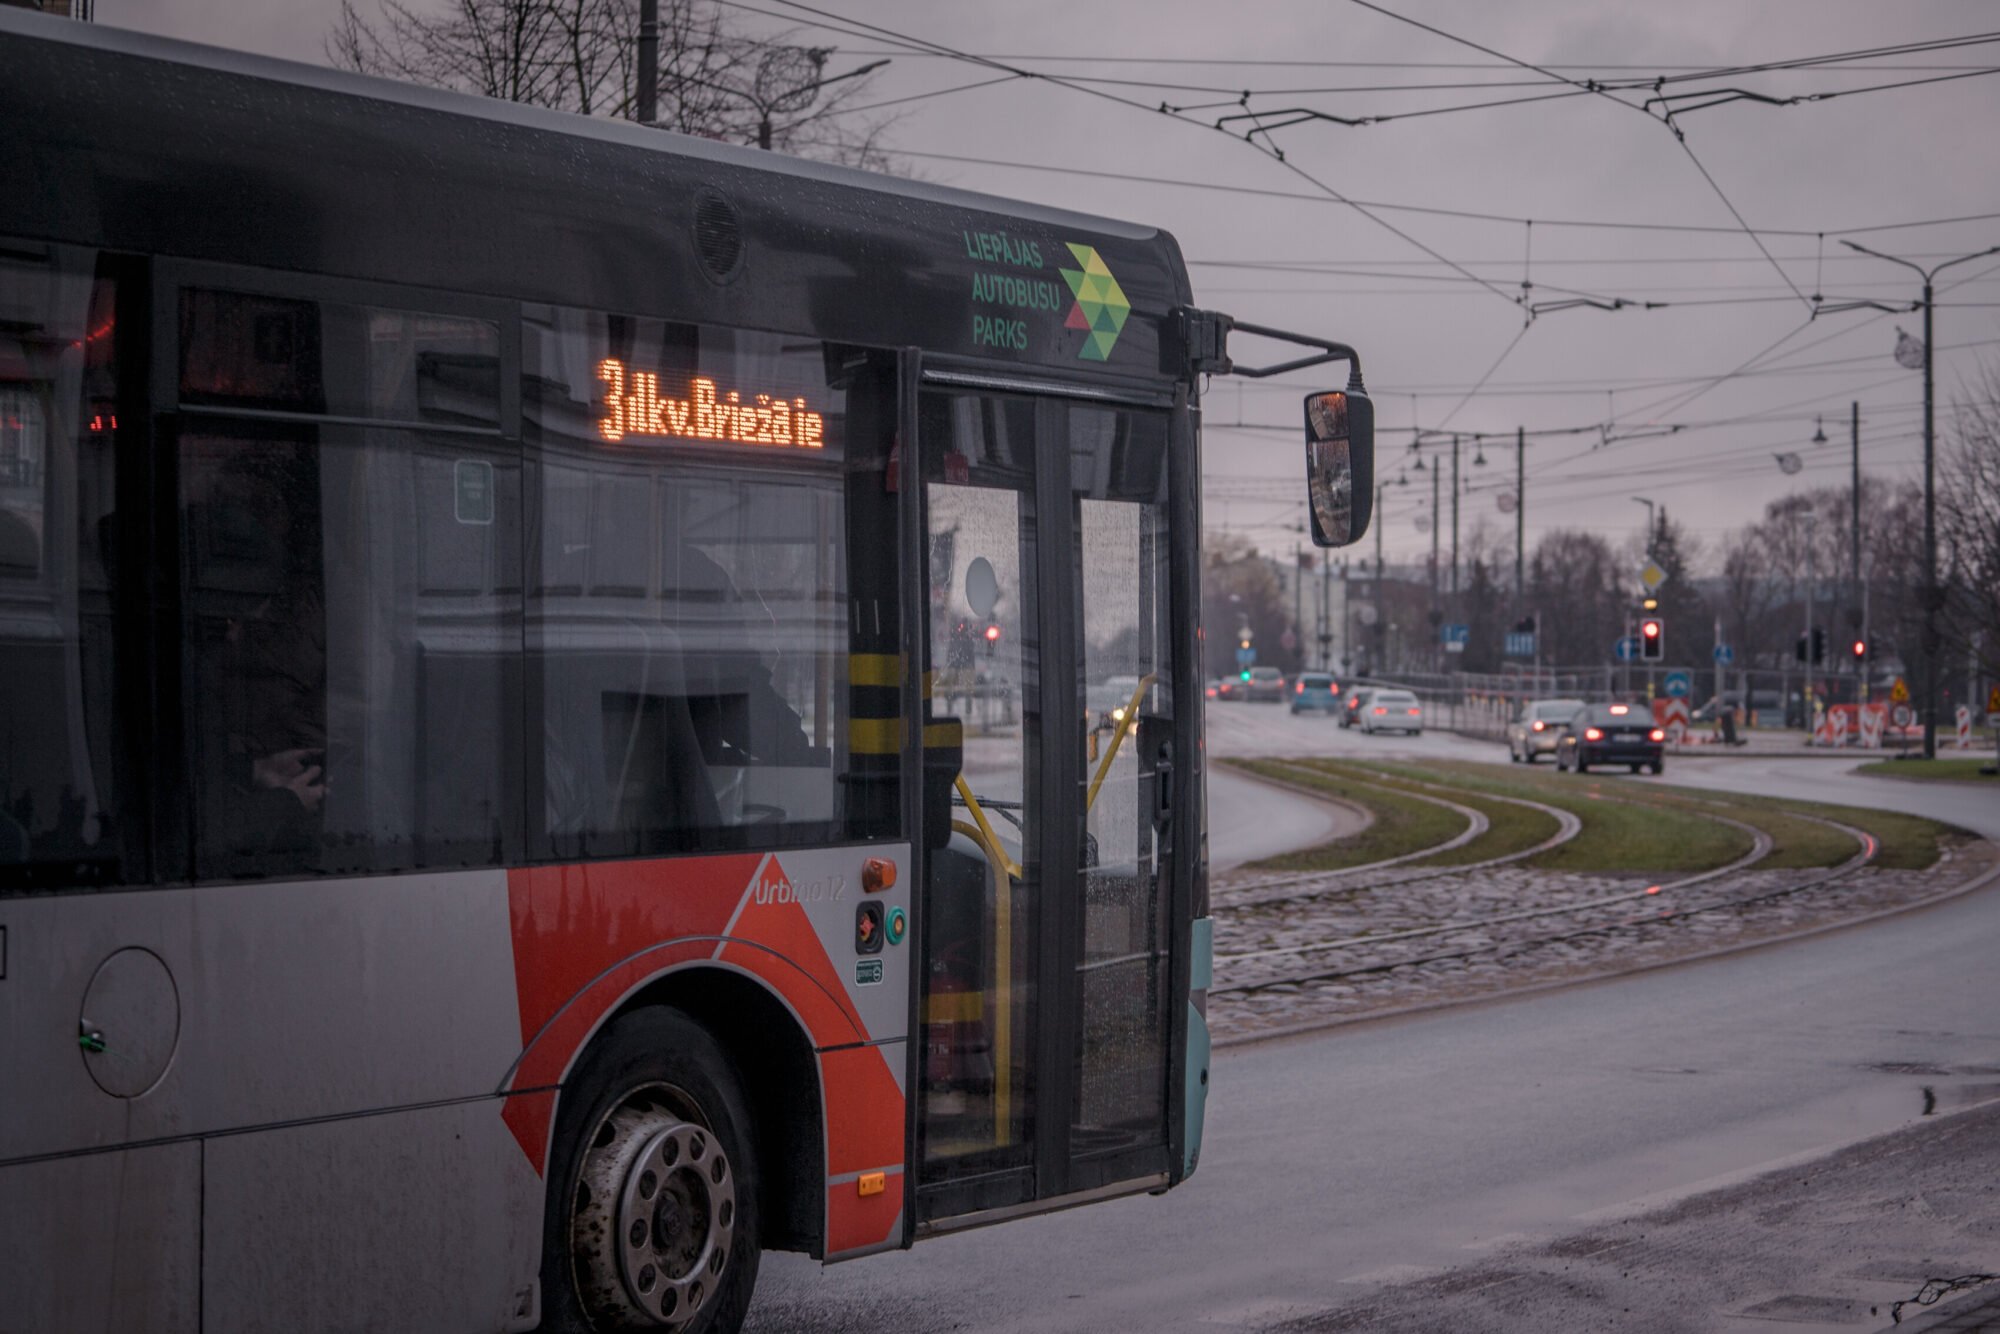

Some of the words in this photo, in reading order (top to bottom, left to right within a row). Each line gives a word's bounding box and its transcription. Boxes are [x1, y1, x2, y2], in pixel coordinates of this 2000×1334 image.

[964, 231, 1042, 267] LIEPĀJAS
[973, 272, 1060, 311] AUTOBUSU
[973, 316, 1027, 350] PARKS
[598, 358, 624, 440] 3
[755, 877, 823, 904] Urbino
